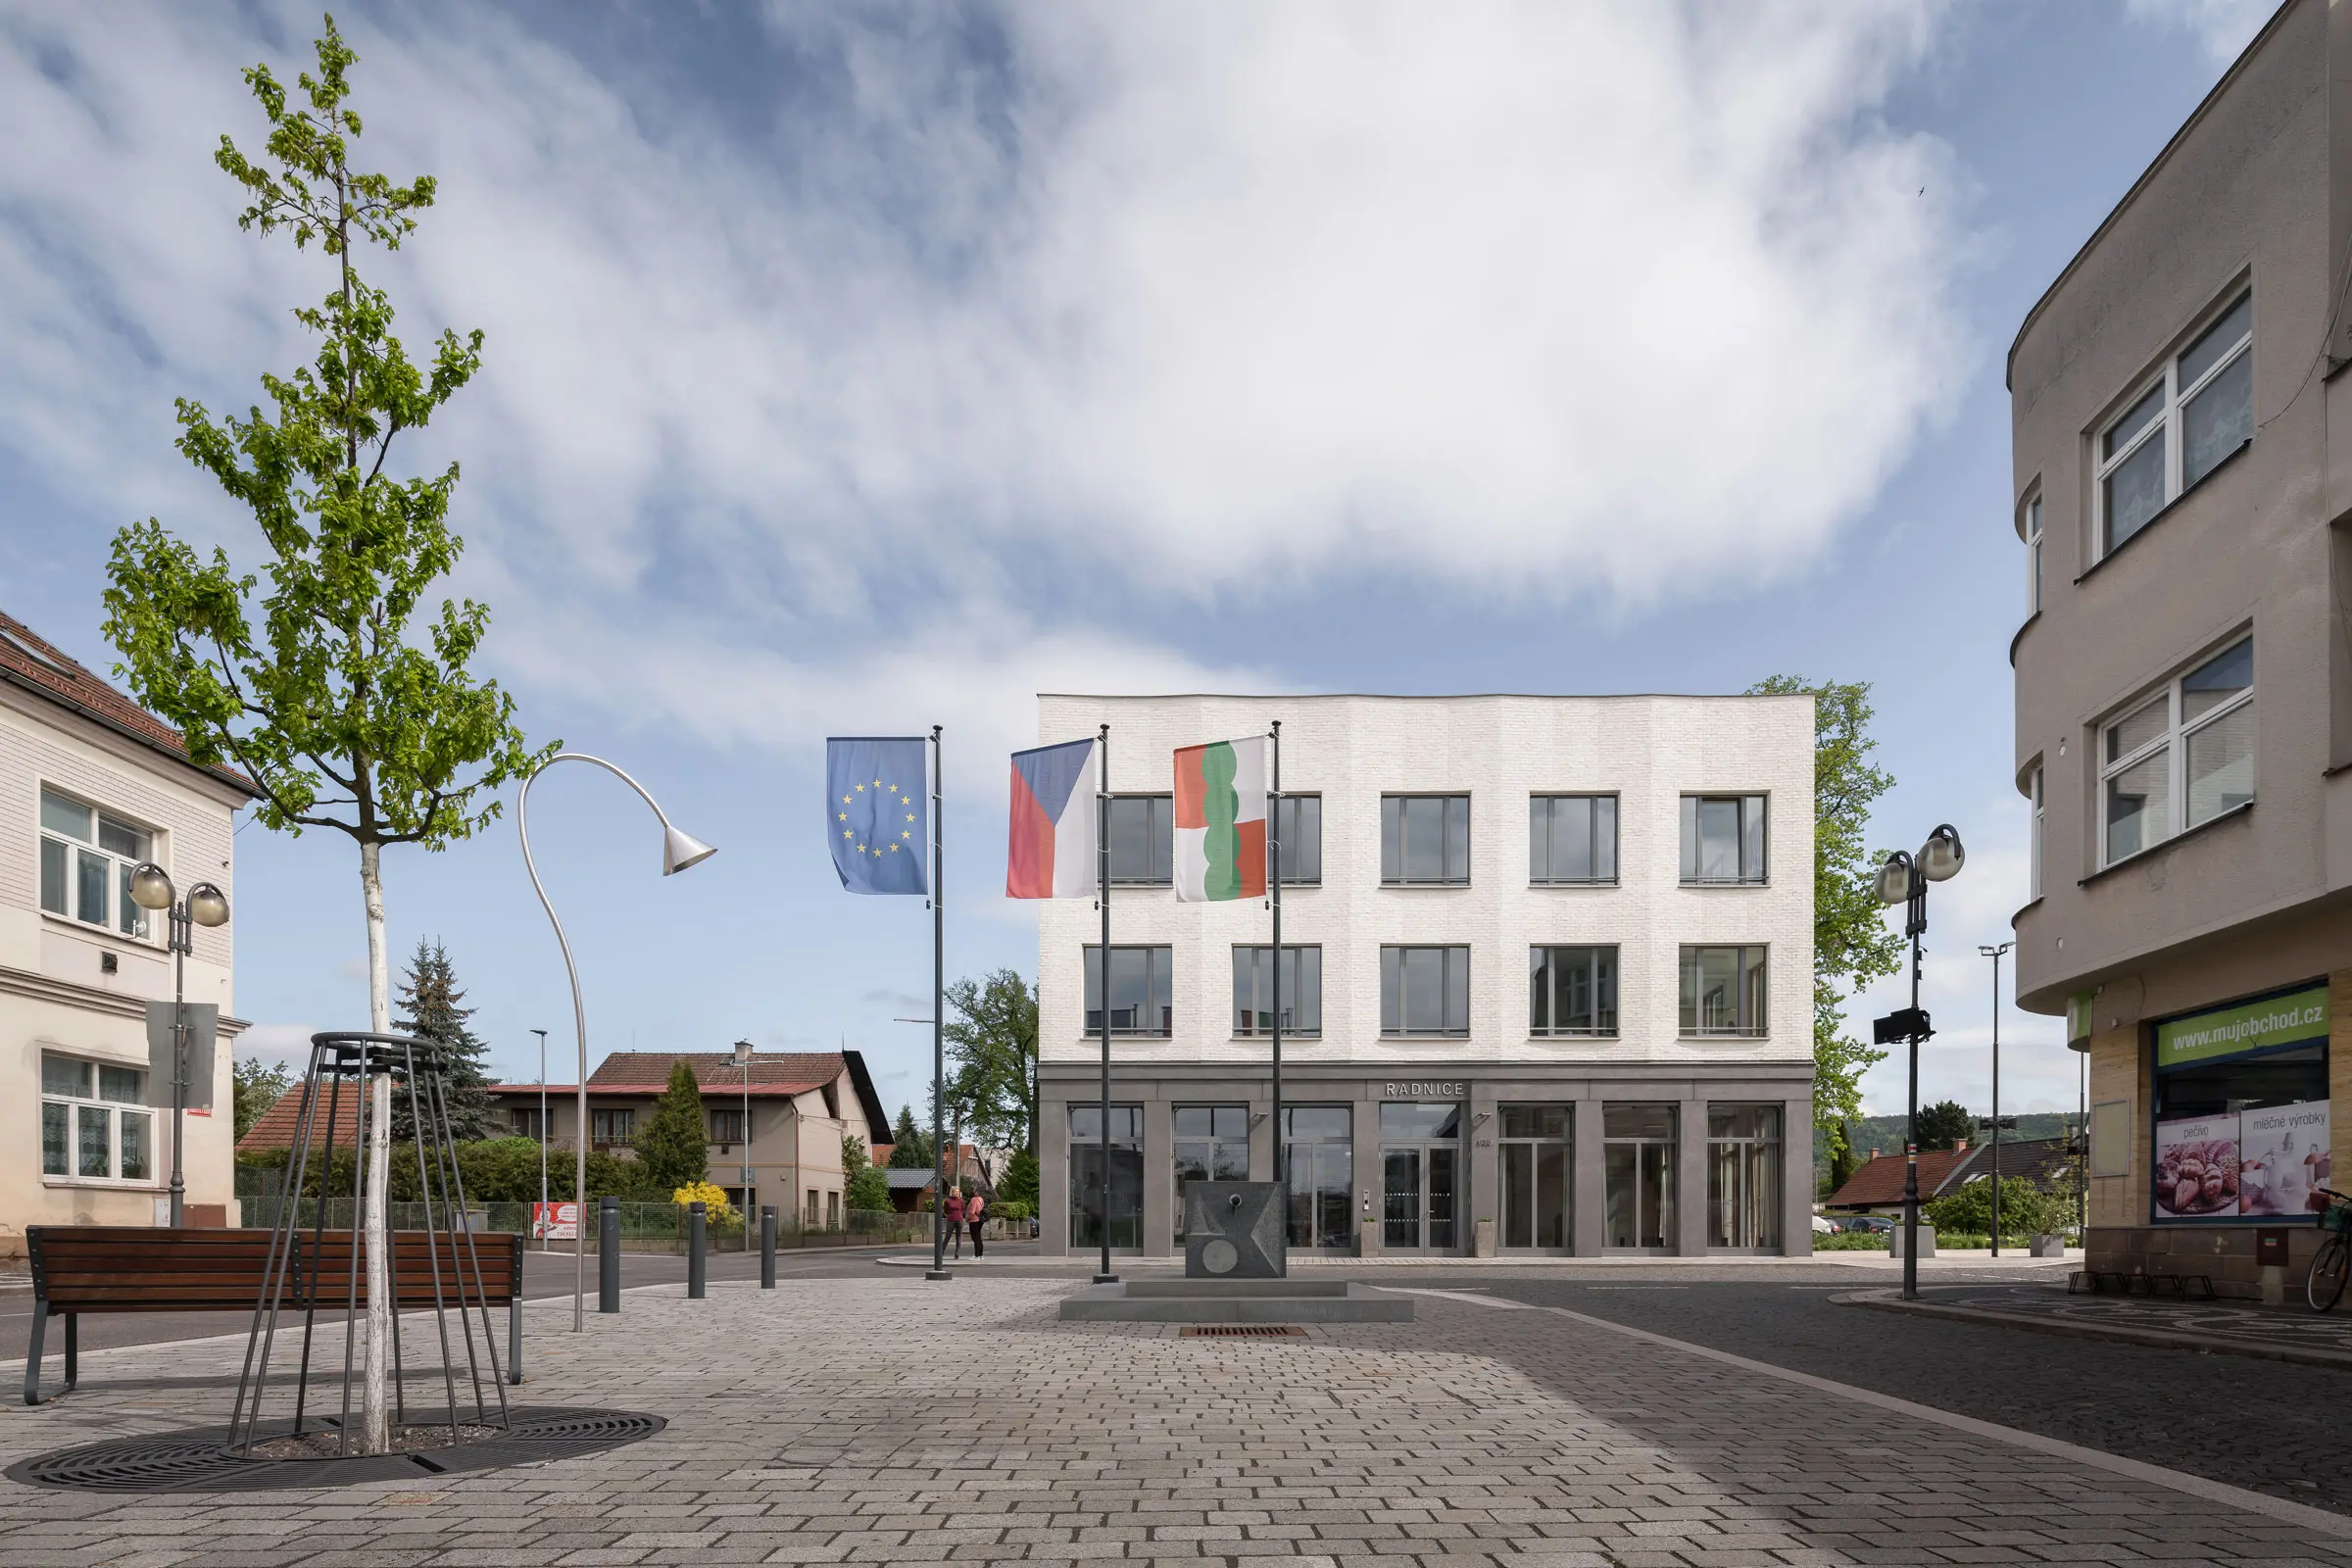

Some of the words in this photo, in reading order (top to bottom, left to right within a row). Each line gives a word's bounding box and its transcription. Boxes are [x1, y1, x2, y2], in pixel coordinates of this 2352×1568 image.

[2173, 1005, 2324, 1051] www.mujobchod.cz
[1386, 1083, 1464, 1096] RADNICE
[2253, 1115, 2285, 1131] mléčné
[2288, 1111, 2327, 1129] výrobky
[2183, 1125, 2209, 1140] pečivo
